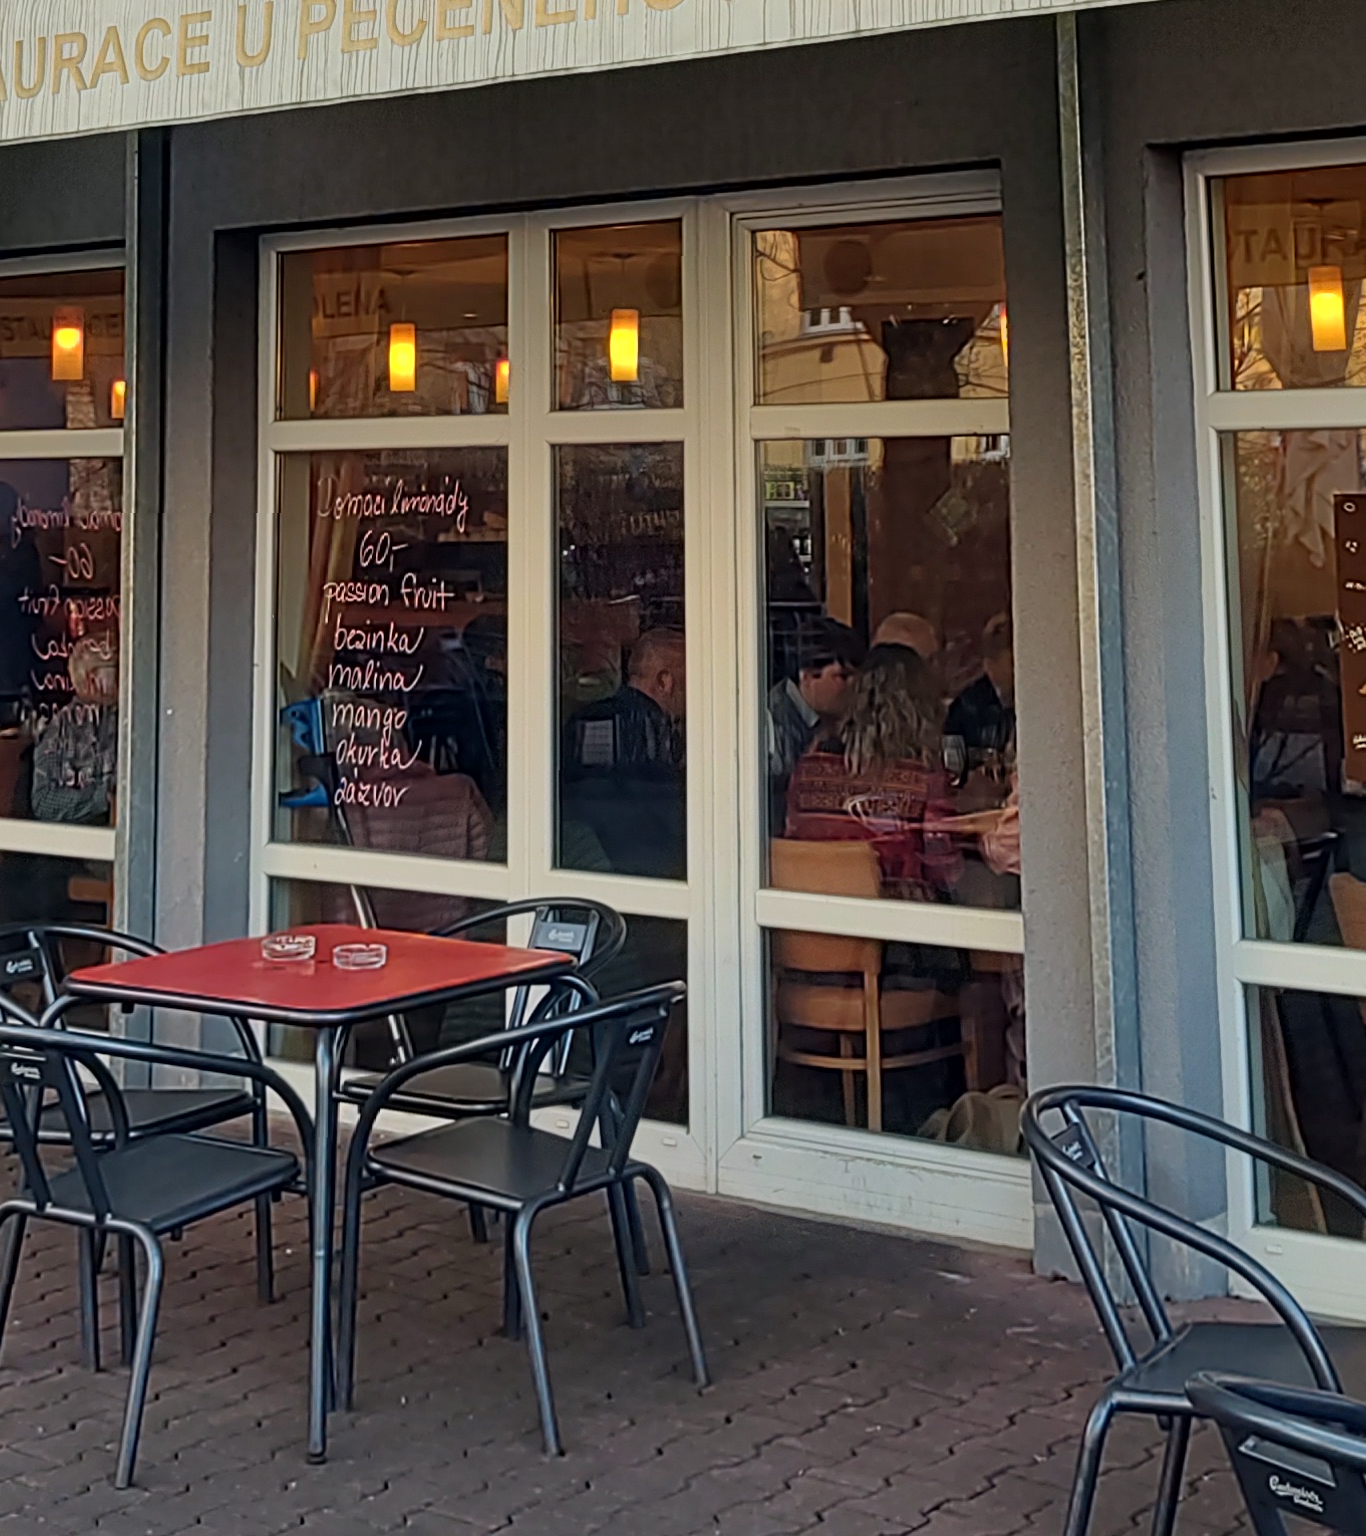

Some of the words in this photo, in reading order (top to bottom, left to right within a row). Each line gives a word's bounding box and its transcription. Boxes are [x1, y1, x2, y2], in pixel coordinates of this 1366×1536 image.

[237, 2, 275, 67] U
[359, 530, 409, 573] 60,-
[322, 581, 389, 624] passion
[400, 572, 455, 611] fruit
[335, 613, 424, 654] bezinka
[328, 659, 424, 692] malina
[332, 702, 408, 746] mango
[336, 732, 423, 770] okurka
[334, 767, 410, 808] zázvor
